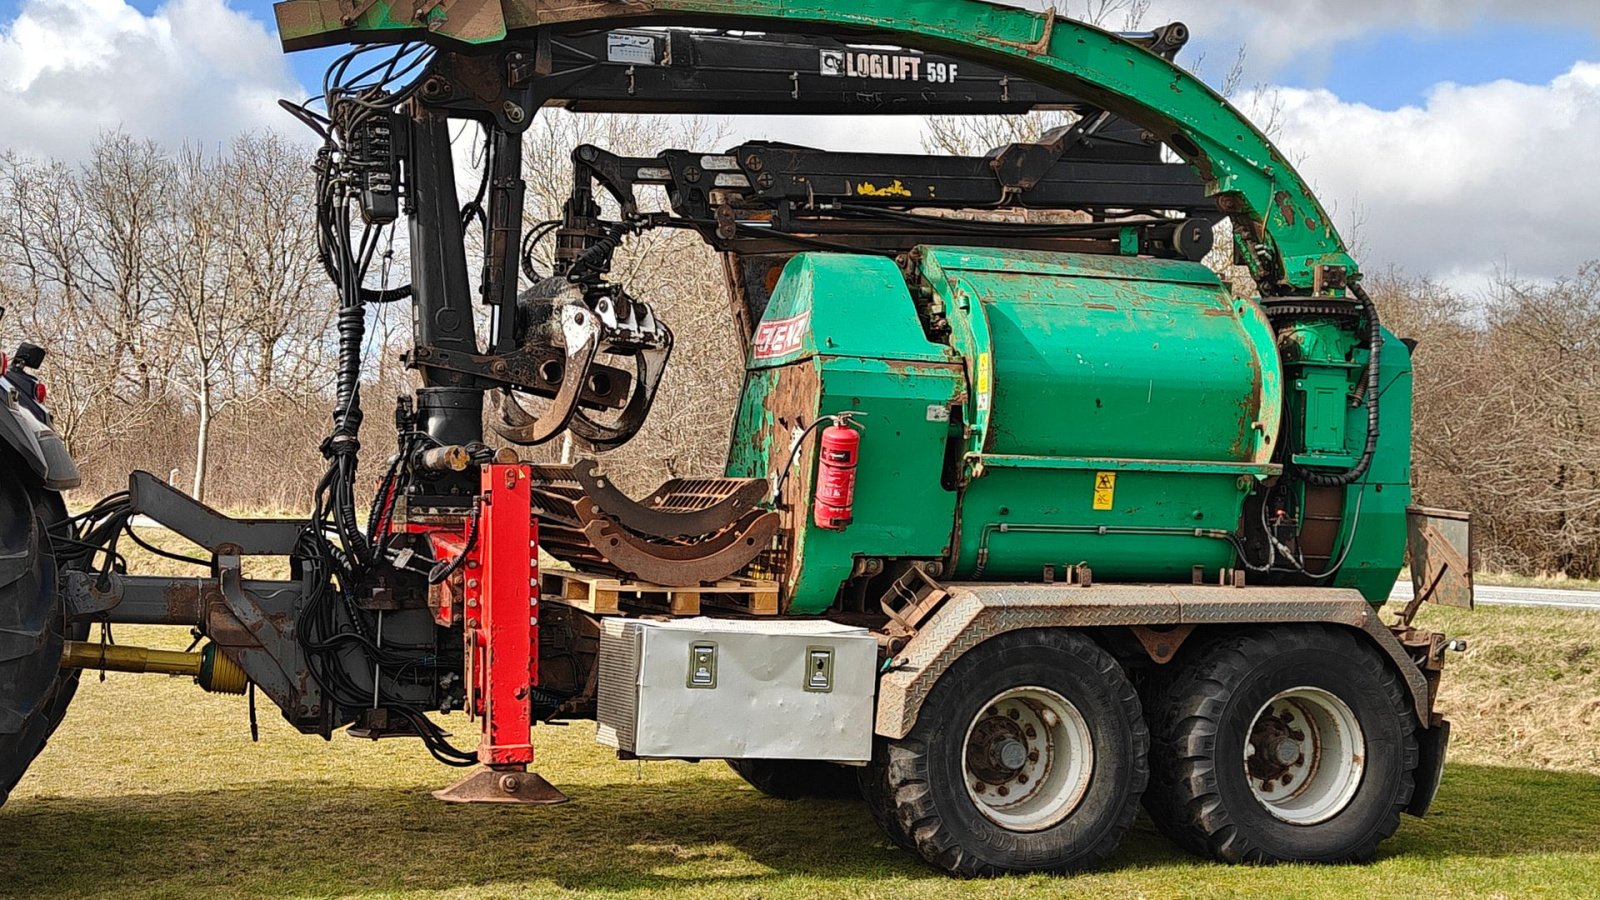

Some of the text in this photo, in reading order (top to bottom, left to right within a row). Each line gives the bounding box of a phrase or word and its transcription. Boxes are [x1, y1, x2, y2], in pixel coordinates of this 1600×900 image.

[846, 52, 958, 83] LOGLIFT 59 F
